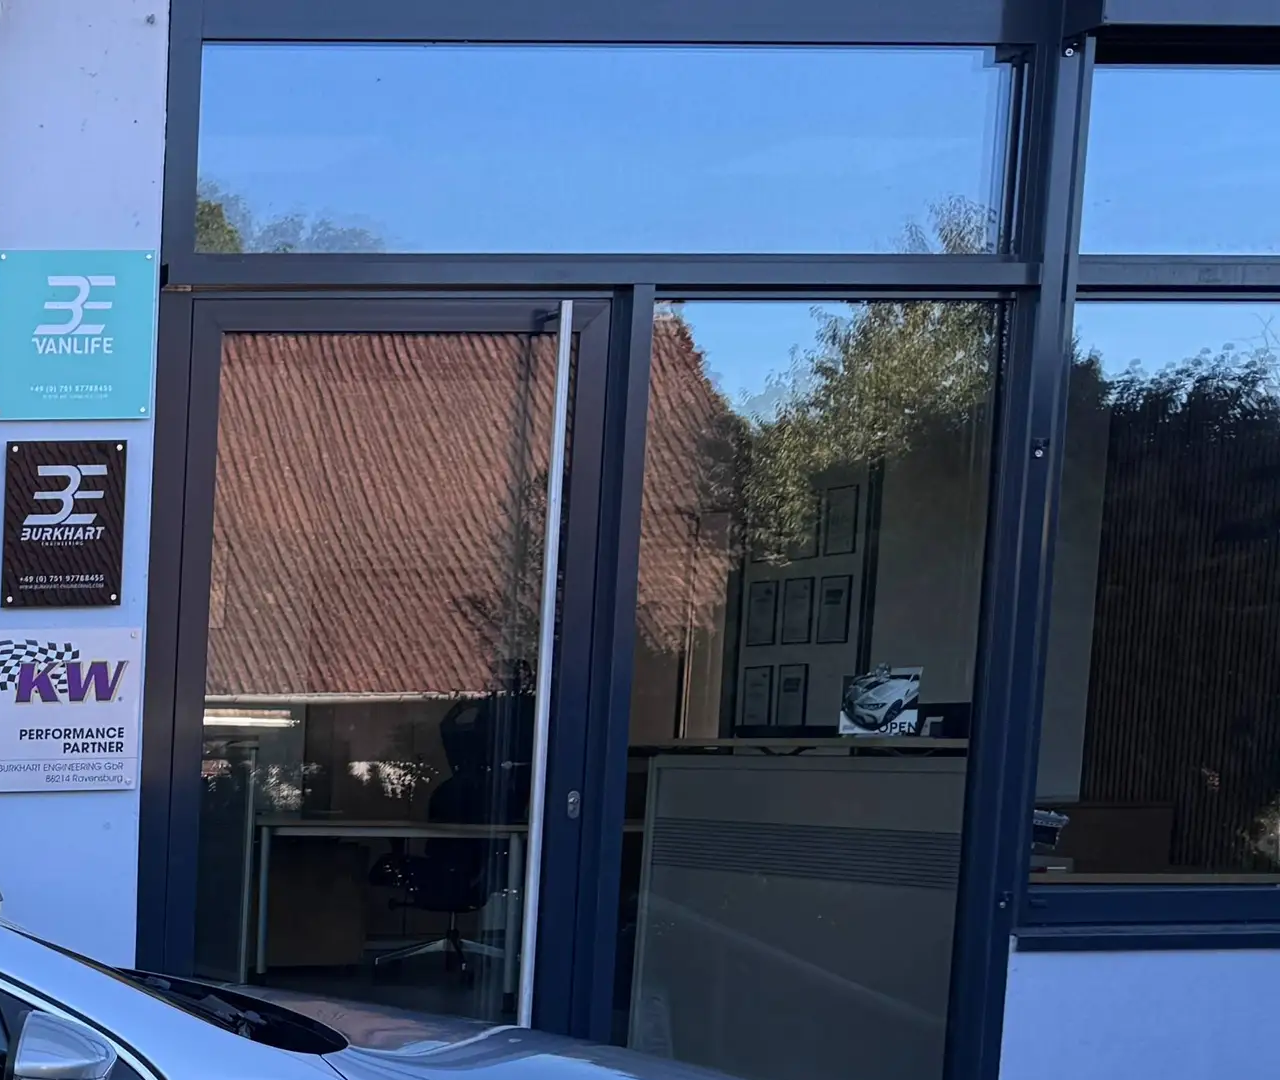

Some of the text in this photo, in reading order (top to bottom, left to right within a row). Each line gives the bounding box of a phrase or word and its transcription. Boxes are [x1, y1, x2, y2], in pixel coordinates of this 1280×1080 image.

[32, 337, 114, 354] VANLIFE
[20, 526, 106, 541] BURKHART
[20, 575, 34, 583] +49
[35, 575, 47, 583] (0)
[15, 660, 129, 704] KW
[879, 721, 918, 733] OPEN
[19, 727, 125, 741] PERFORMANCE
[63, 741, 124, 754] PARTNER
[43, 762, 102, 772] ENGINEERING
[72, 774, 124, 784] Ravensburg
